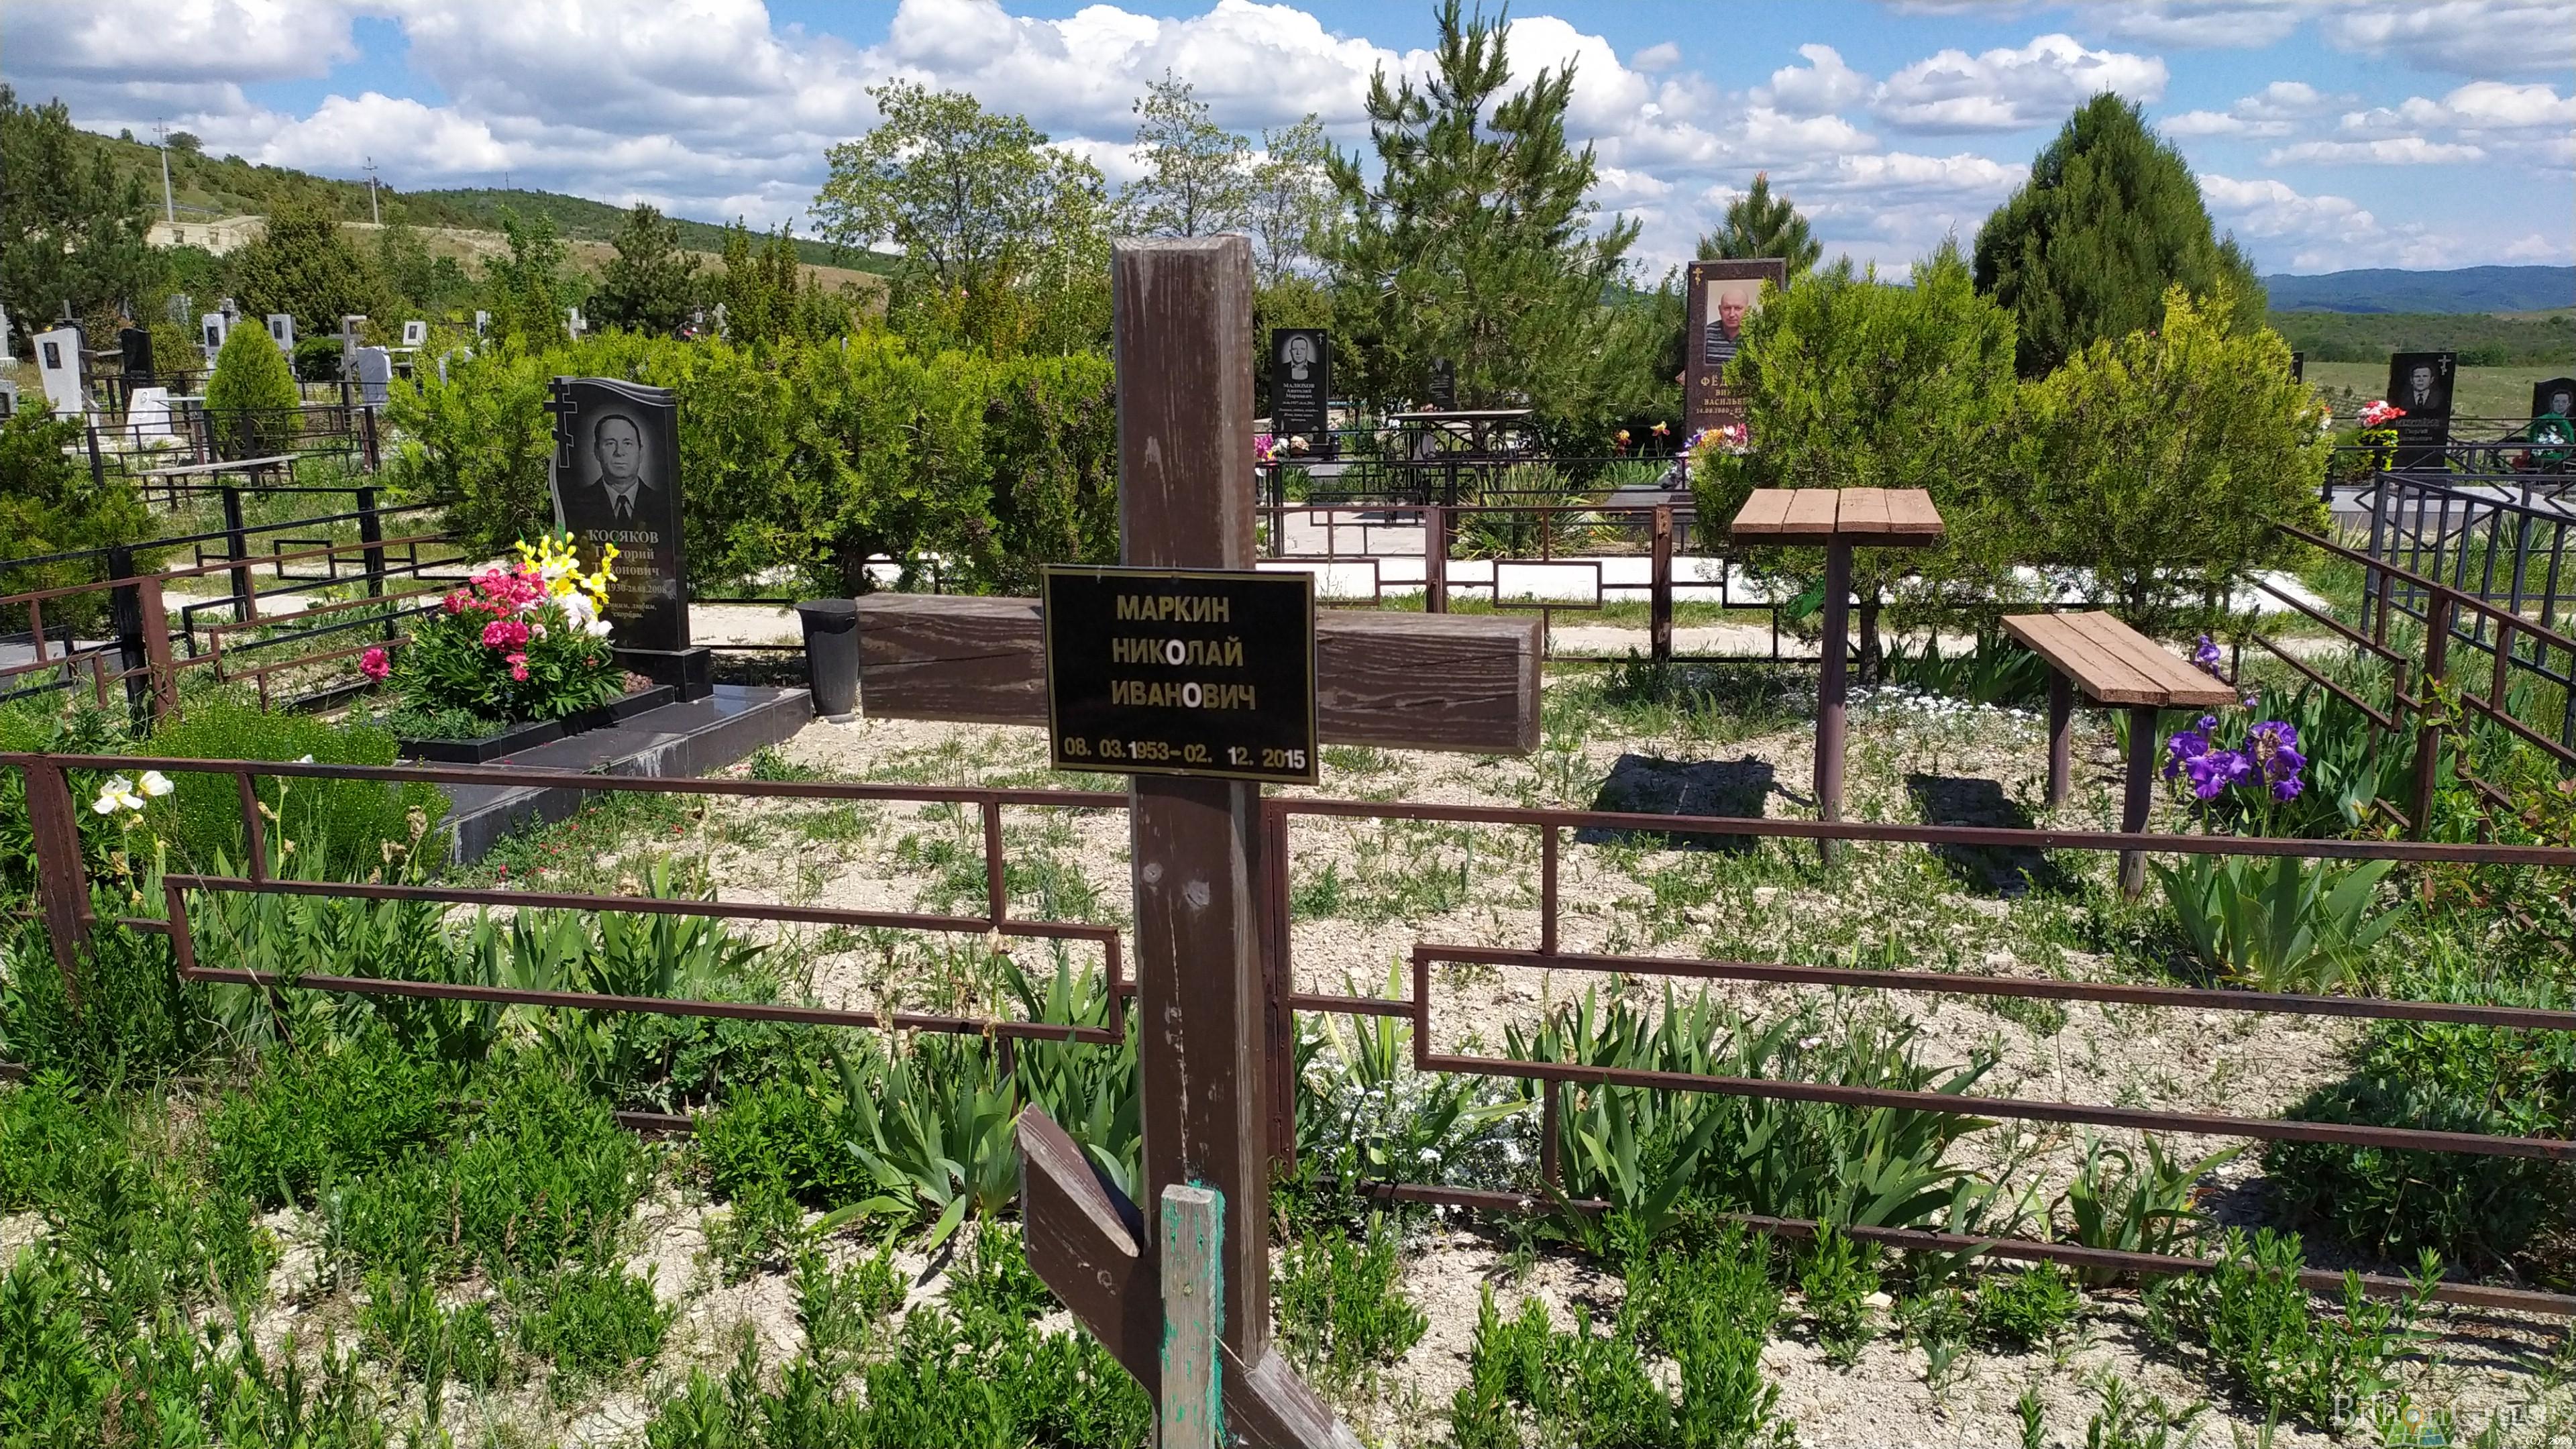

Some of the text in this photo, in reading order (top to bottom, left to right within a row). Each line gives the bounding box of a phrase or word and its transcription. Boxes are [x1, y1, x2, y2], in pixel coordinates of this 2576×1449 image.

[1704, 398, 1748, 406] ВАСИЛЬЕ
[589, 529, 659, 544] КОСЯКОВ
[592, 562, 659, 576] Тхонович
[1116, 594, 1230, 623] МАРКИН
[1112, 636, 1244, 667] НИКОЛАЙ
[1111, 680, 1256, 710] ИВАНОВИЧ
[1228, 746, 1254, 766] 12.
[1262, 749, 1306, 769] 2015
